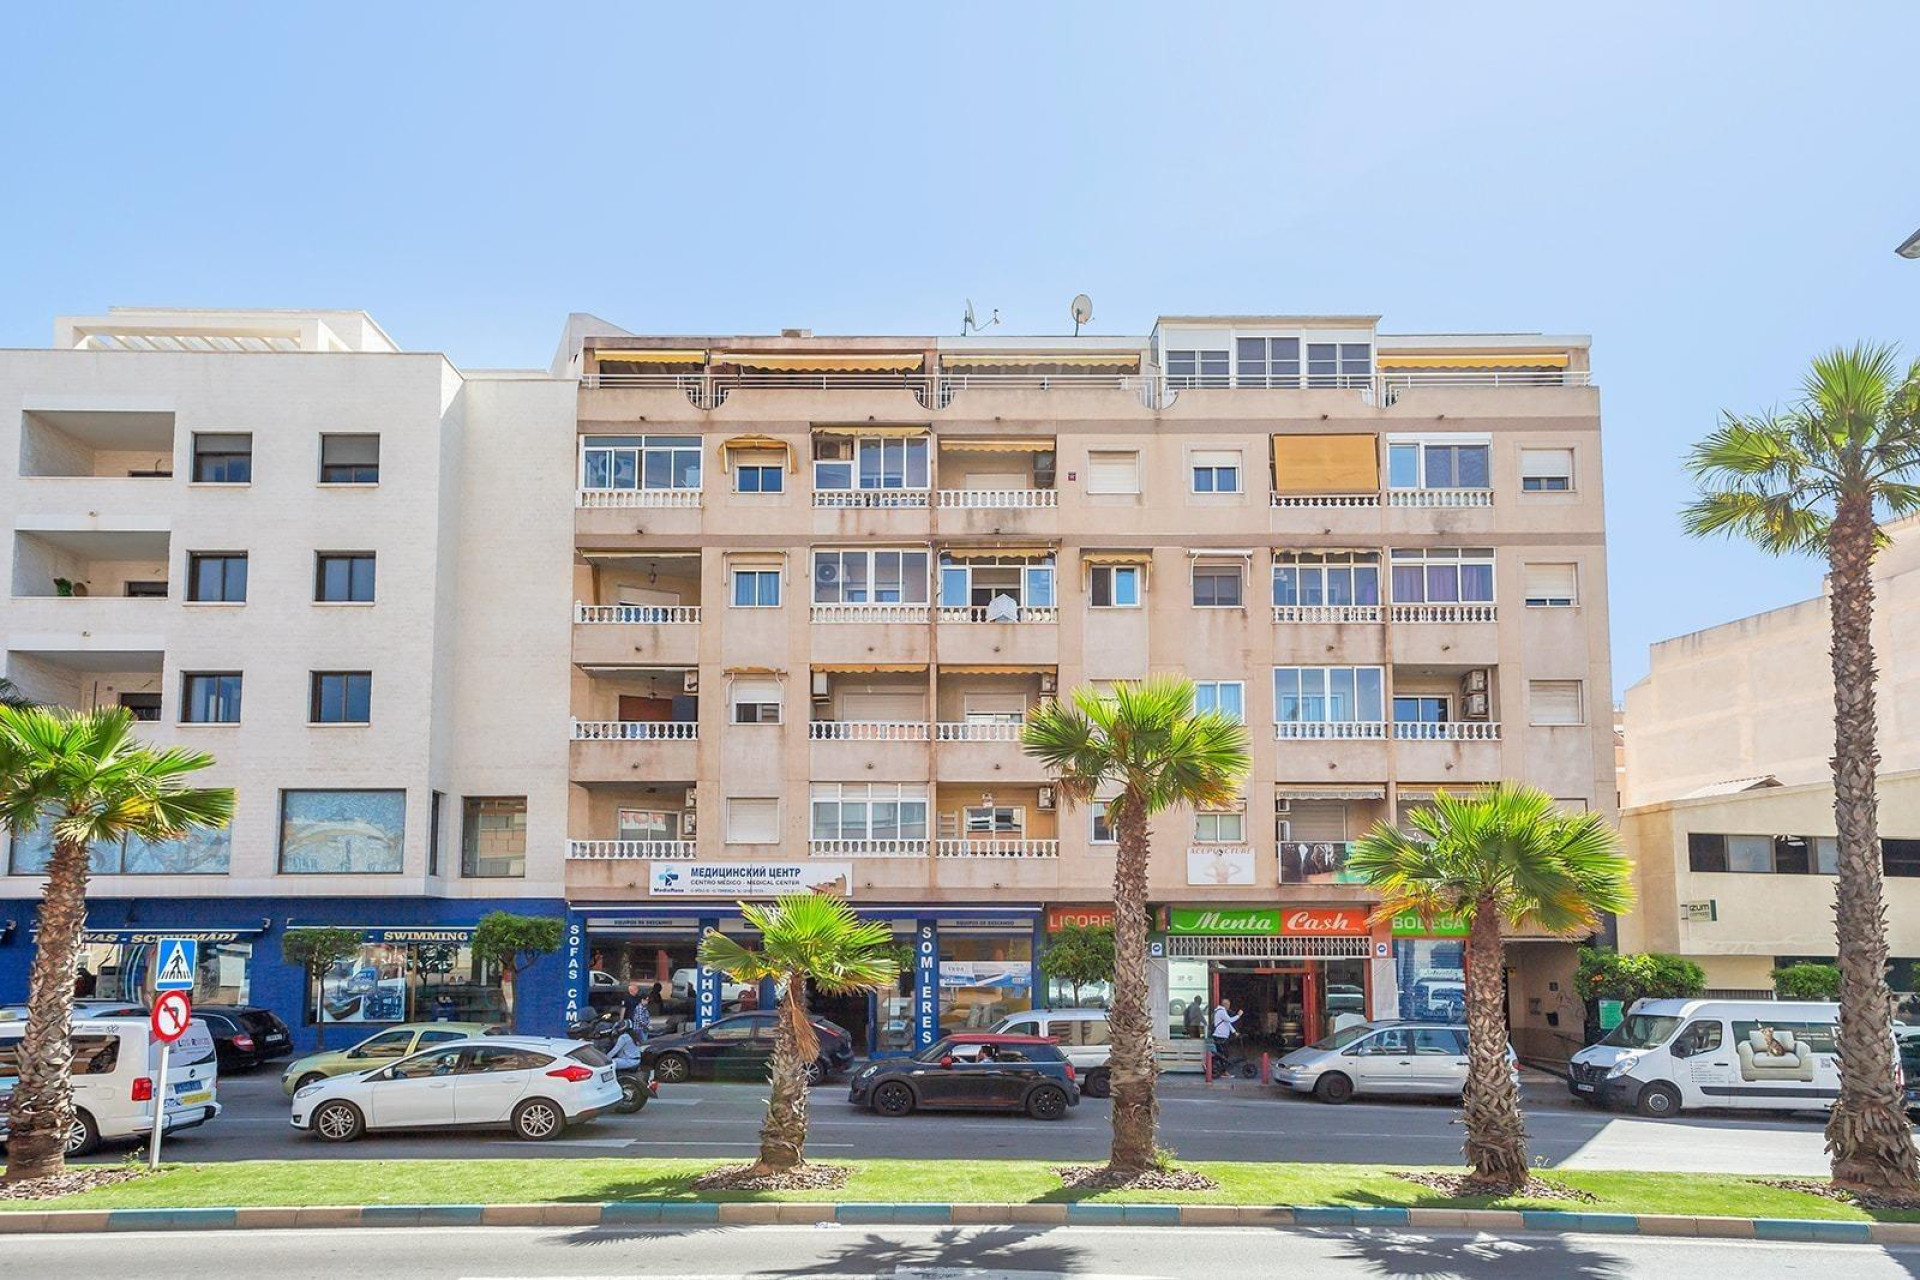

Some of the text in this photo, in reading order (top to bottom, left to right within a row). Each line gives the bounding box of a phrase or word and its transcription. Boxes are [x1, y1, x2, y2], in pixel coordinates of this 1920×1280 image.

[690, 866, 801, 879] МЕДИЦИНСКИЙ ЦЕНТР
[1049, 913, 1114, 928] LICORE
[1175, 911, 1361, 932] Menta Cash
[383, 931, 469, 941] SWIMMING
[565, 924, 580, 1027] SOFAS CAM
[920, 926, 934, 1044] SOMIERES
